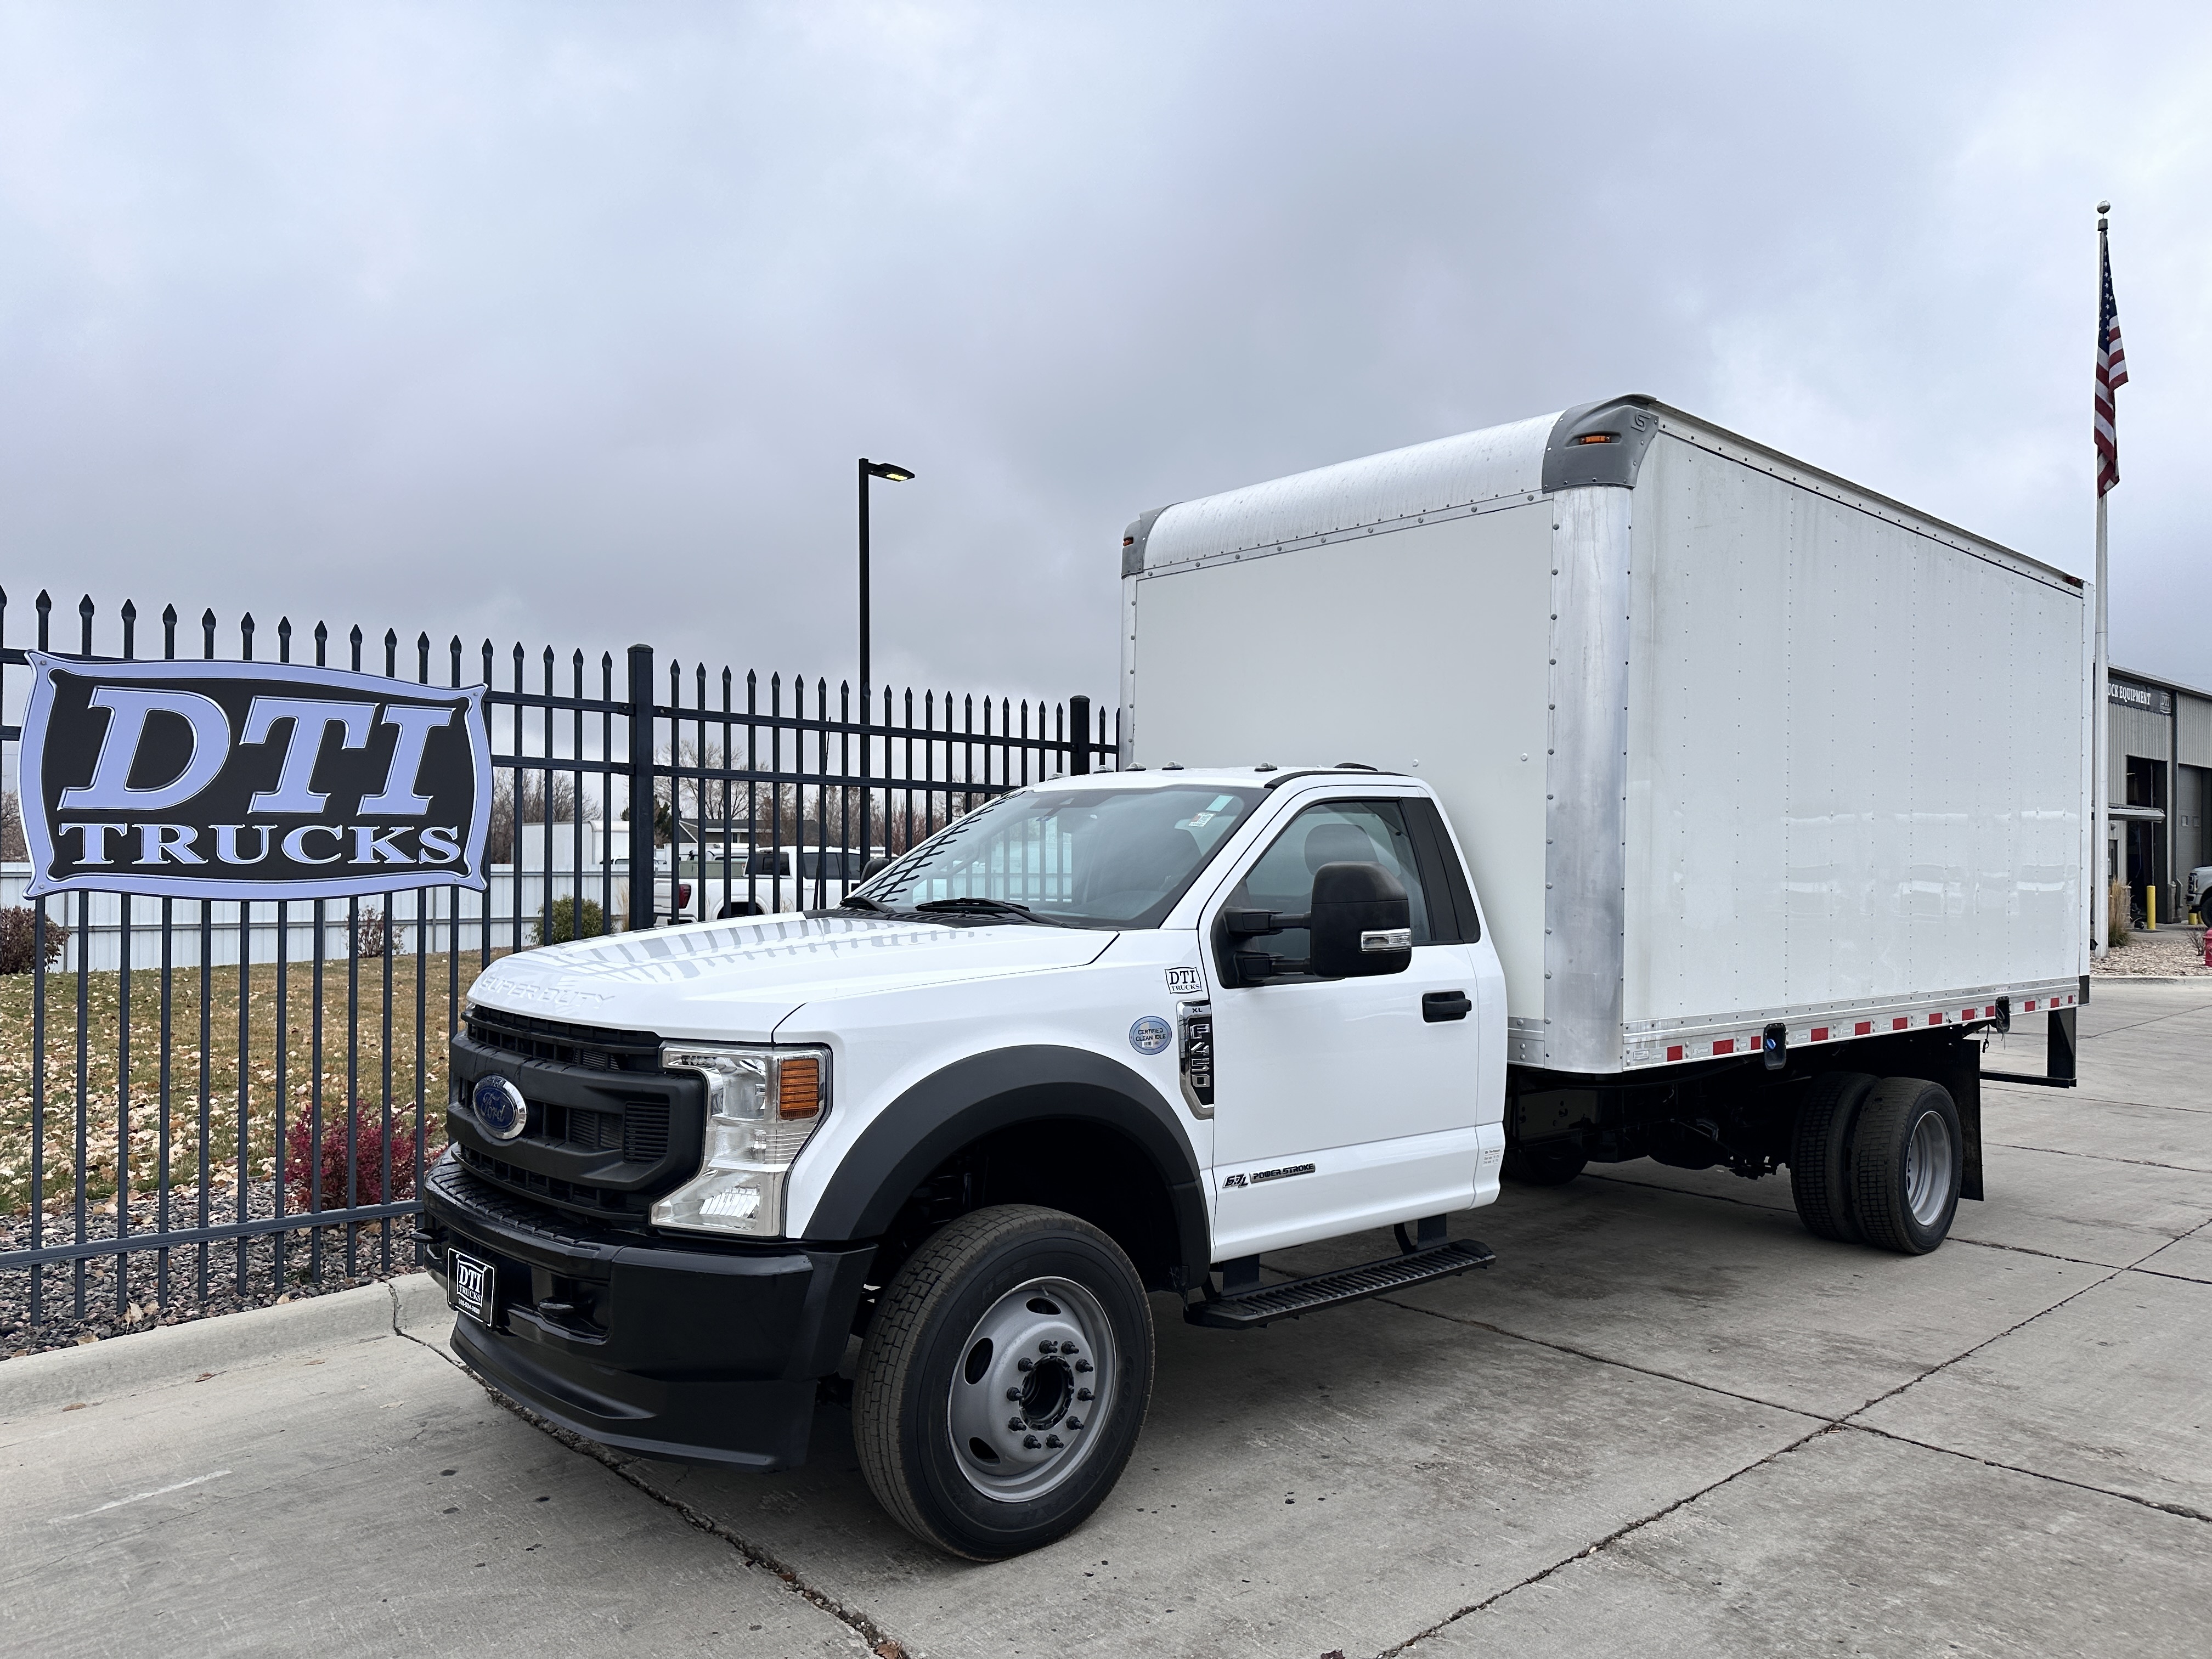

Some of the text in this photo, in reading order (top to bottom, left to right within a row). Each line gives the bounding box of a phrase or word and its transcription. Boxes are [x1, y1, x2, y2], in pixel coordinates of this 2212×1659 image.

[2108, 683, 2151, 705] UCK EQUIPMENT
[56, 685, 456, 817] DTI
[58, 822, 462, 866] TRUCKS
[1169, 970, 1196, 985] DTI
[479, 976, 616, 1009] SUPER DUTY
[480, 1092, 506, 1123] Ford
[1223, 1173, 1249, 1188] 6.7L
[1253, 1169, 1282, 1180] POWER
[1283, 1163, 1314, 1175] STROKE
[459, 1265, 482, 1293] DTI
[459, 1284, 481, 1302] TRUCKS
